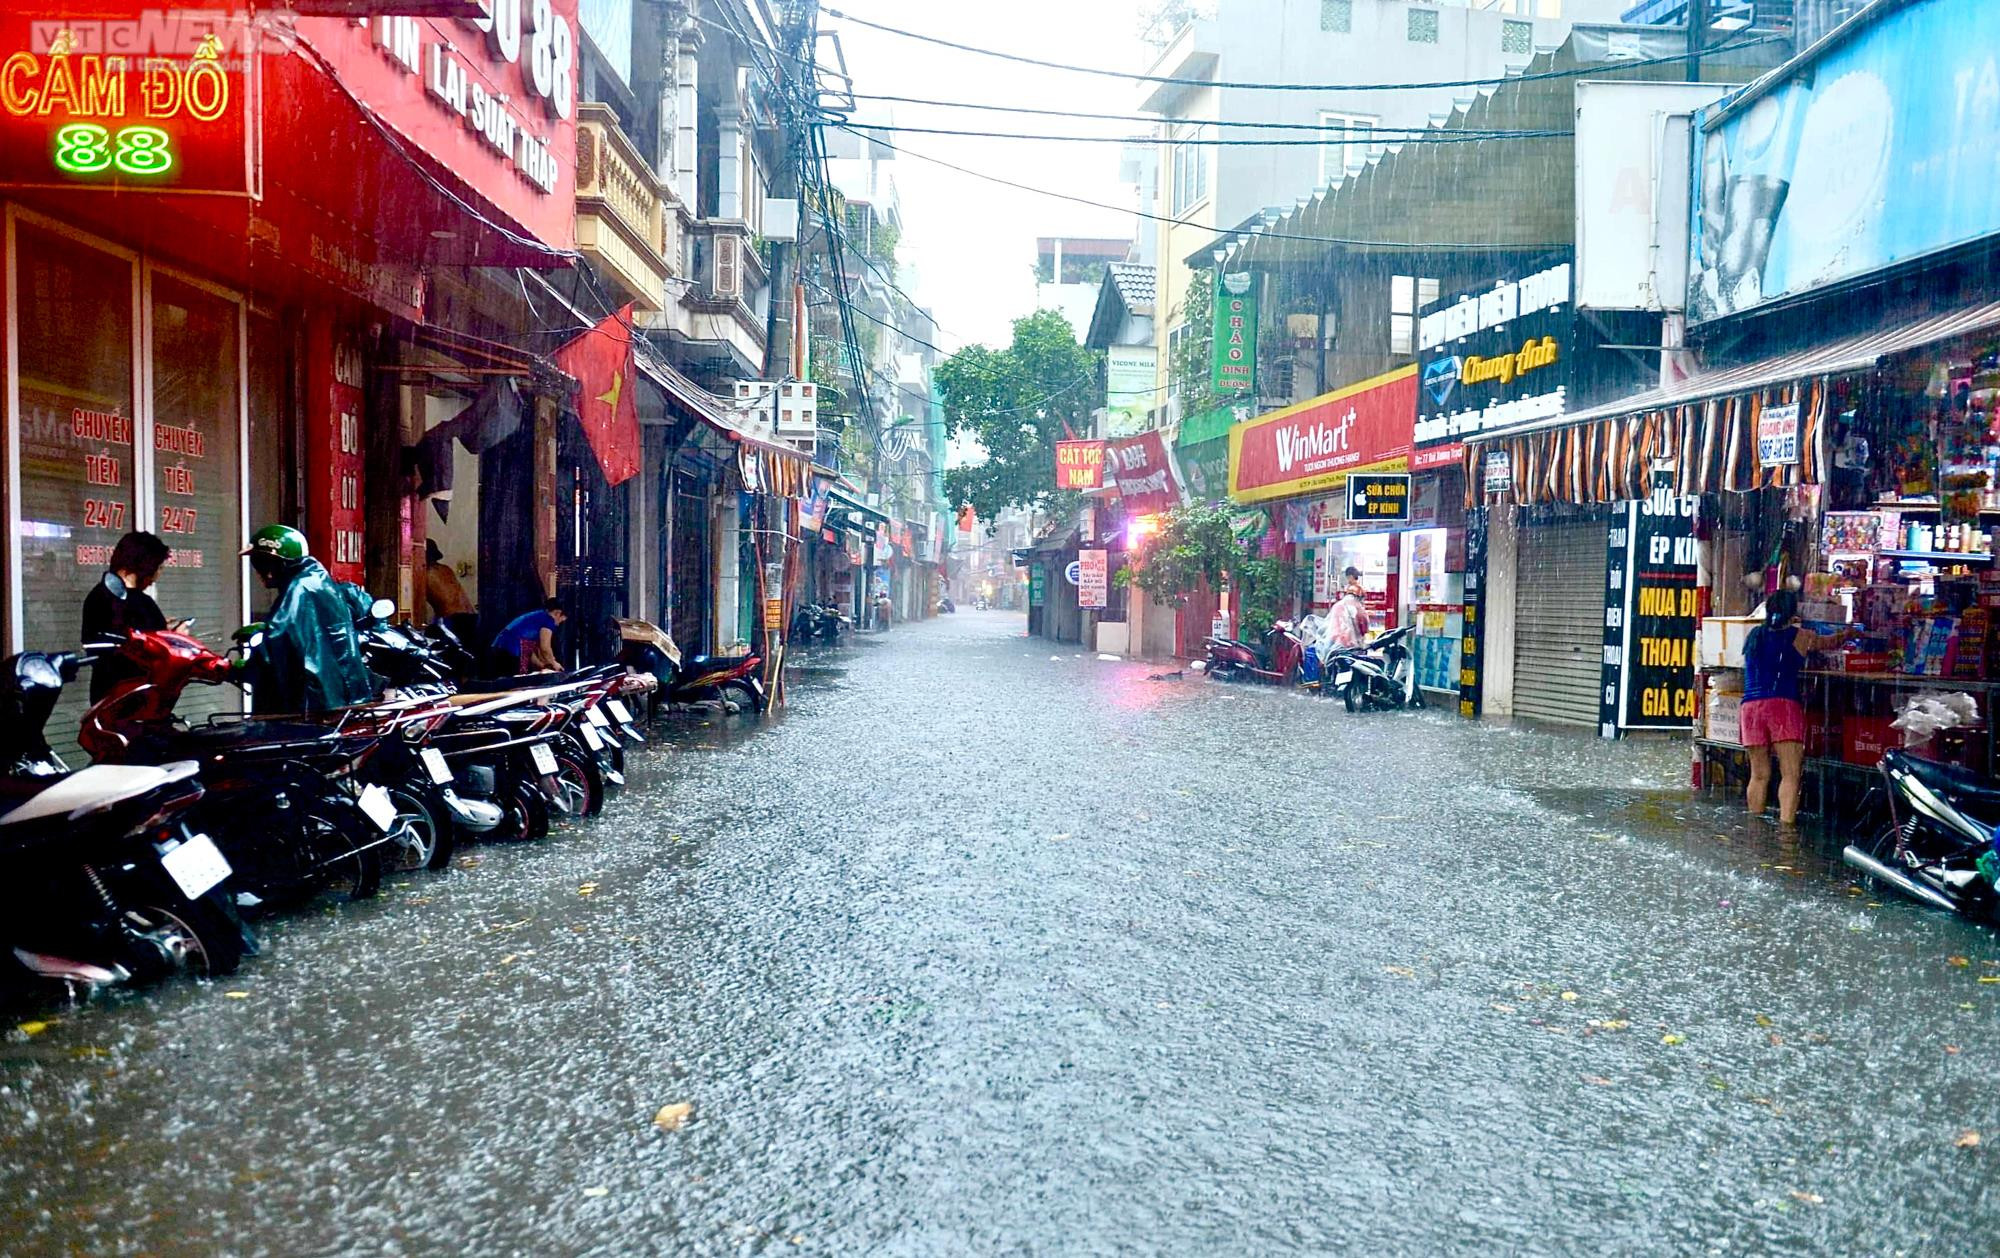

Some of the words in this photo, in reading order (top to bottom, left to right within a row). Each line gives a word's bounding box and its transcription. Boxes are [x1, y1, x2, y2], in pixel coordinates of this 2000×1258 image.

[141, 33, 229, 121] ĐỒ
[532, 0, 573, 120] 88
[472, 82, 516, 160] SUẤT
[56, 123, 172, 173] 88
[1462, 353, 1516, 385] Chung
[1515, 335, 1557, 375] Anh
[72, 404, 131, 446] CHUYỂN
[154, 420, 204, 457] CHUYỂN
[85, 447, 120, 486] TIỀN
[163, 457, 194, 495] TIỀN
[1068, 469, 1094, 485] NAM
[84, 499, 125, 529] 24/7
[1642, 480, 1676, 516] SỬA
[162, 507, 197, 533] 24/7
[259, 538, 282, 549] Grab
[1650, 526, 1669, 565] ÉP
[1639, 587, 1676, 616] MUA
[1640, 637, 1688, 673] THOẠI
[1642, 681, 1670, 716] GIÁ
[1674, 687, 1695, 717] CA
